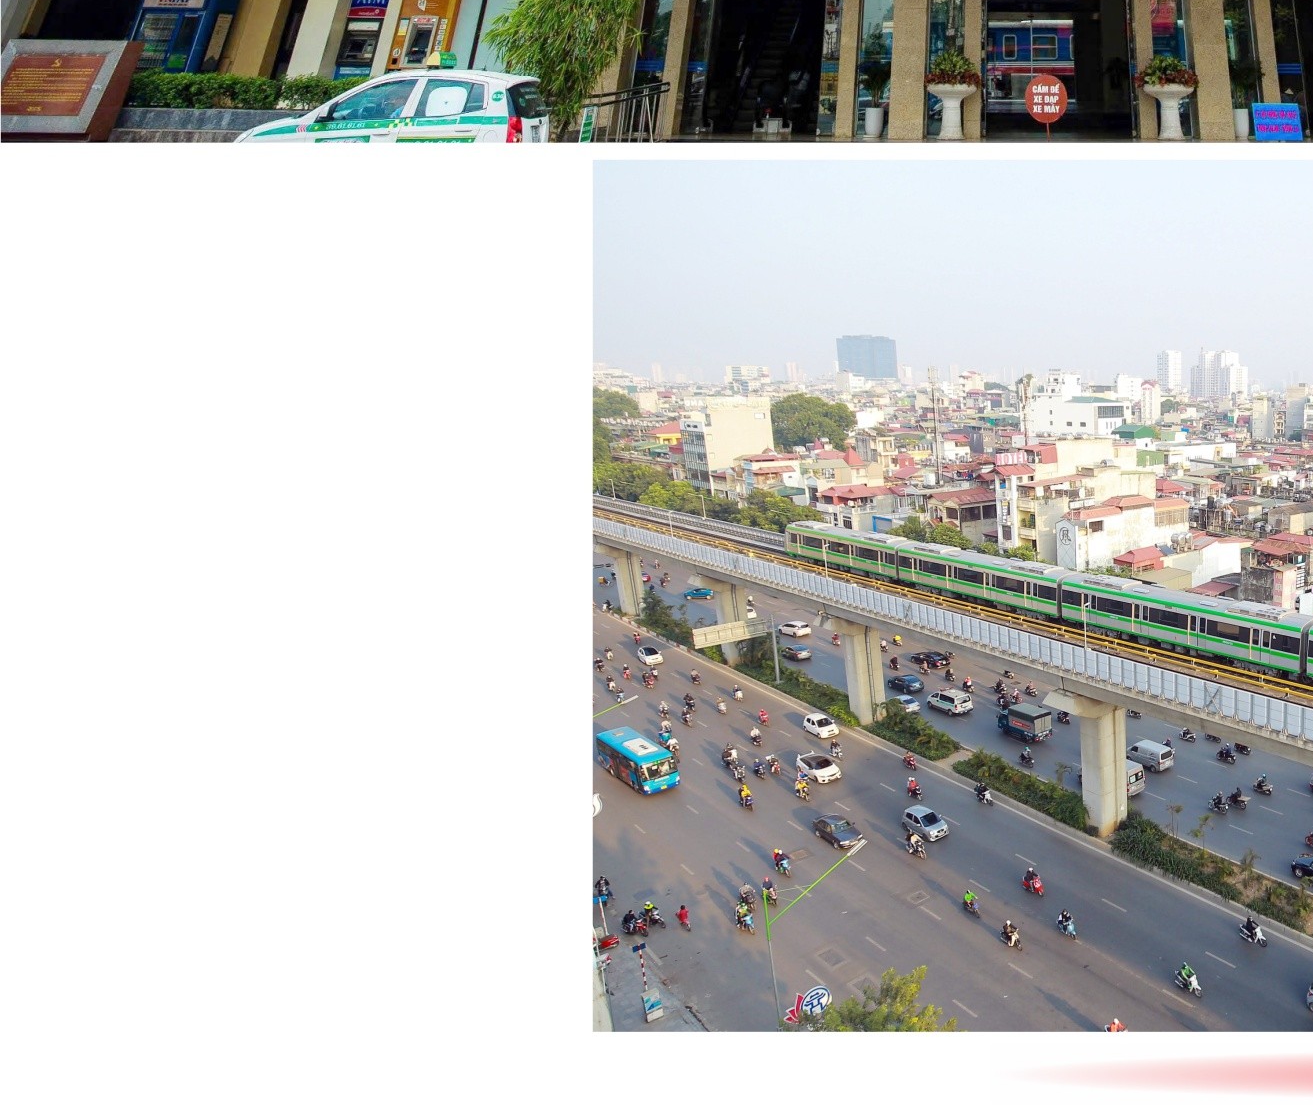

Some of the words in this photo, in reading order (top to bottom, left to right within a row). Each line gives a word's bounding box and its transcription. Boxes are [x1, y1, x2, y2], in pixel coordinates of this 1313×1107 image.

[1032, 83, 1048, 94] CẤM
[1033, 95, 1043, 103] XE
[1033, 105, 1043, 113] XE
